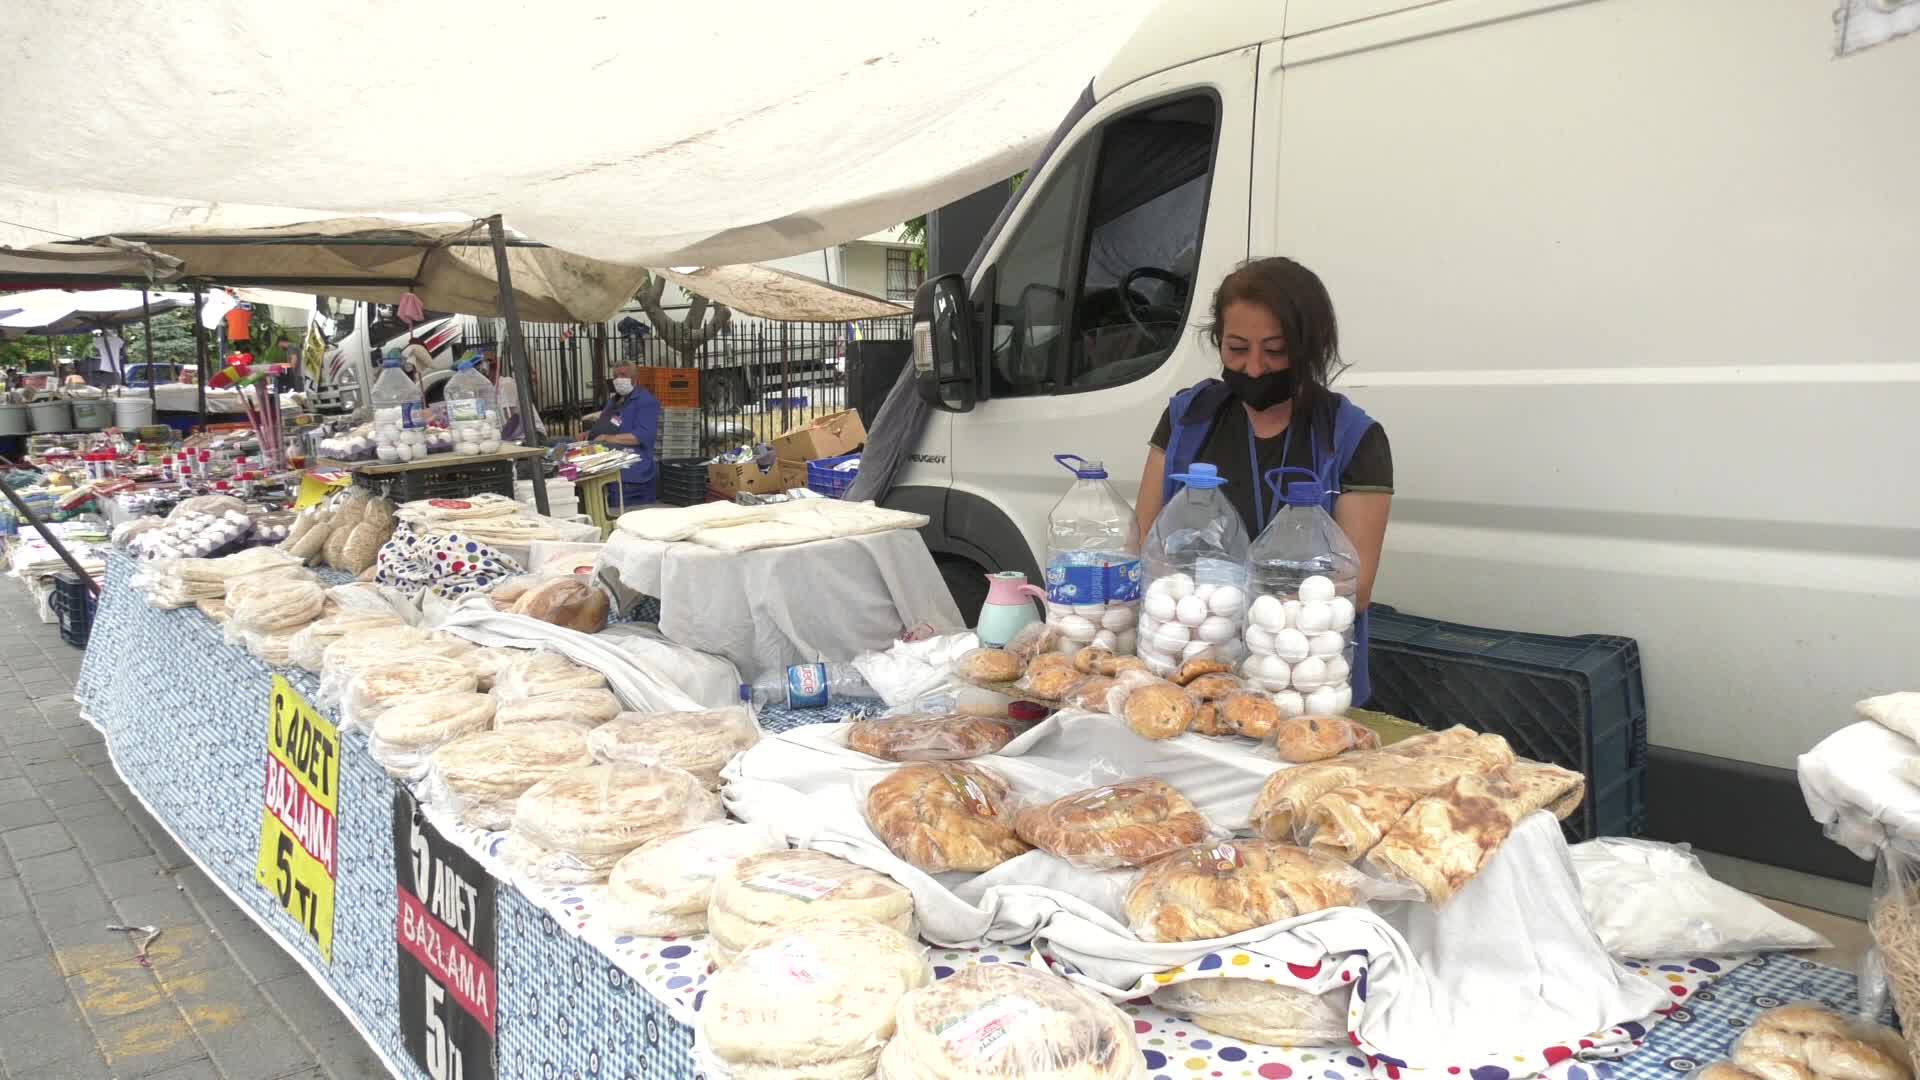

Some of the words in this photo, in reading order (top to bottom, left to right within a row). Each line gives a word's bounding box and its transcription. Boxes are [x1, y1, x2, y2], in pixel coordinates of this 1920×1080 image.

[274, 694, 284, 748] 6
[286, 708, 333, 796] ADET
[266, 758, 333, 872] BAZLAMA
[276, 831, 293, 909] 5
[295, 879, 320, 943] TL
[411, 812, 430, 905] 5
[431, 857, 477, 946] ADET
[403, 901, 489, 1017] BAZLAMA
[425, 973, 447, 1080] 5
